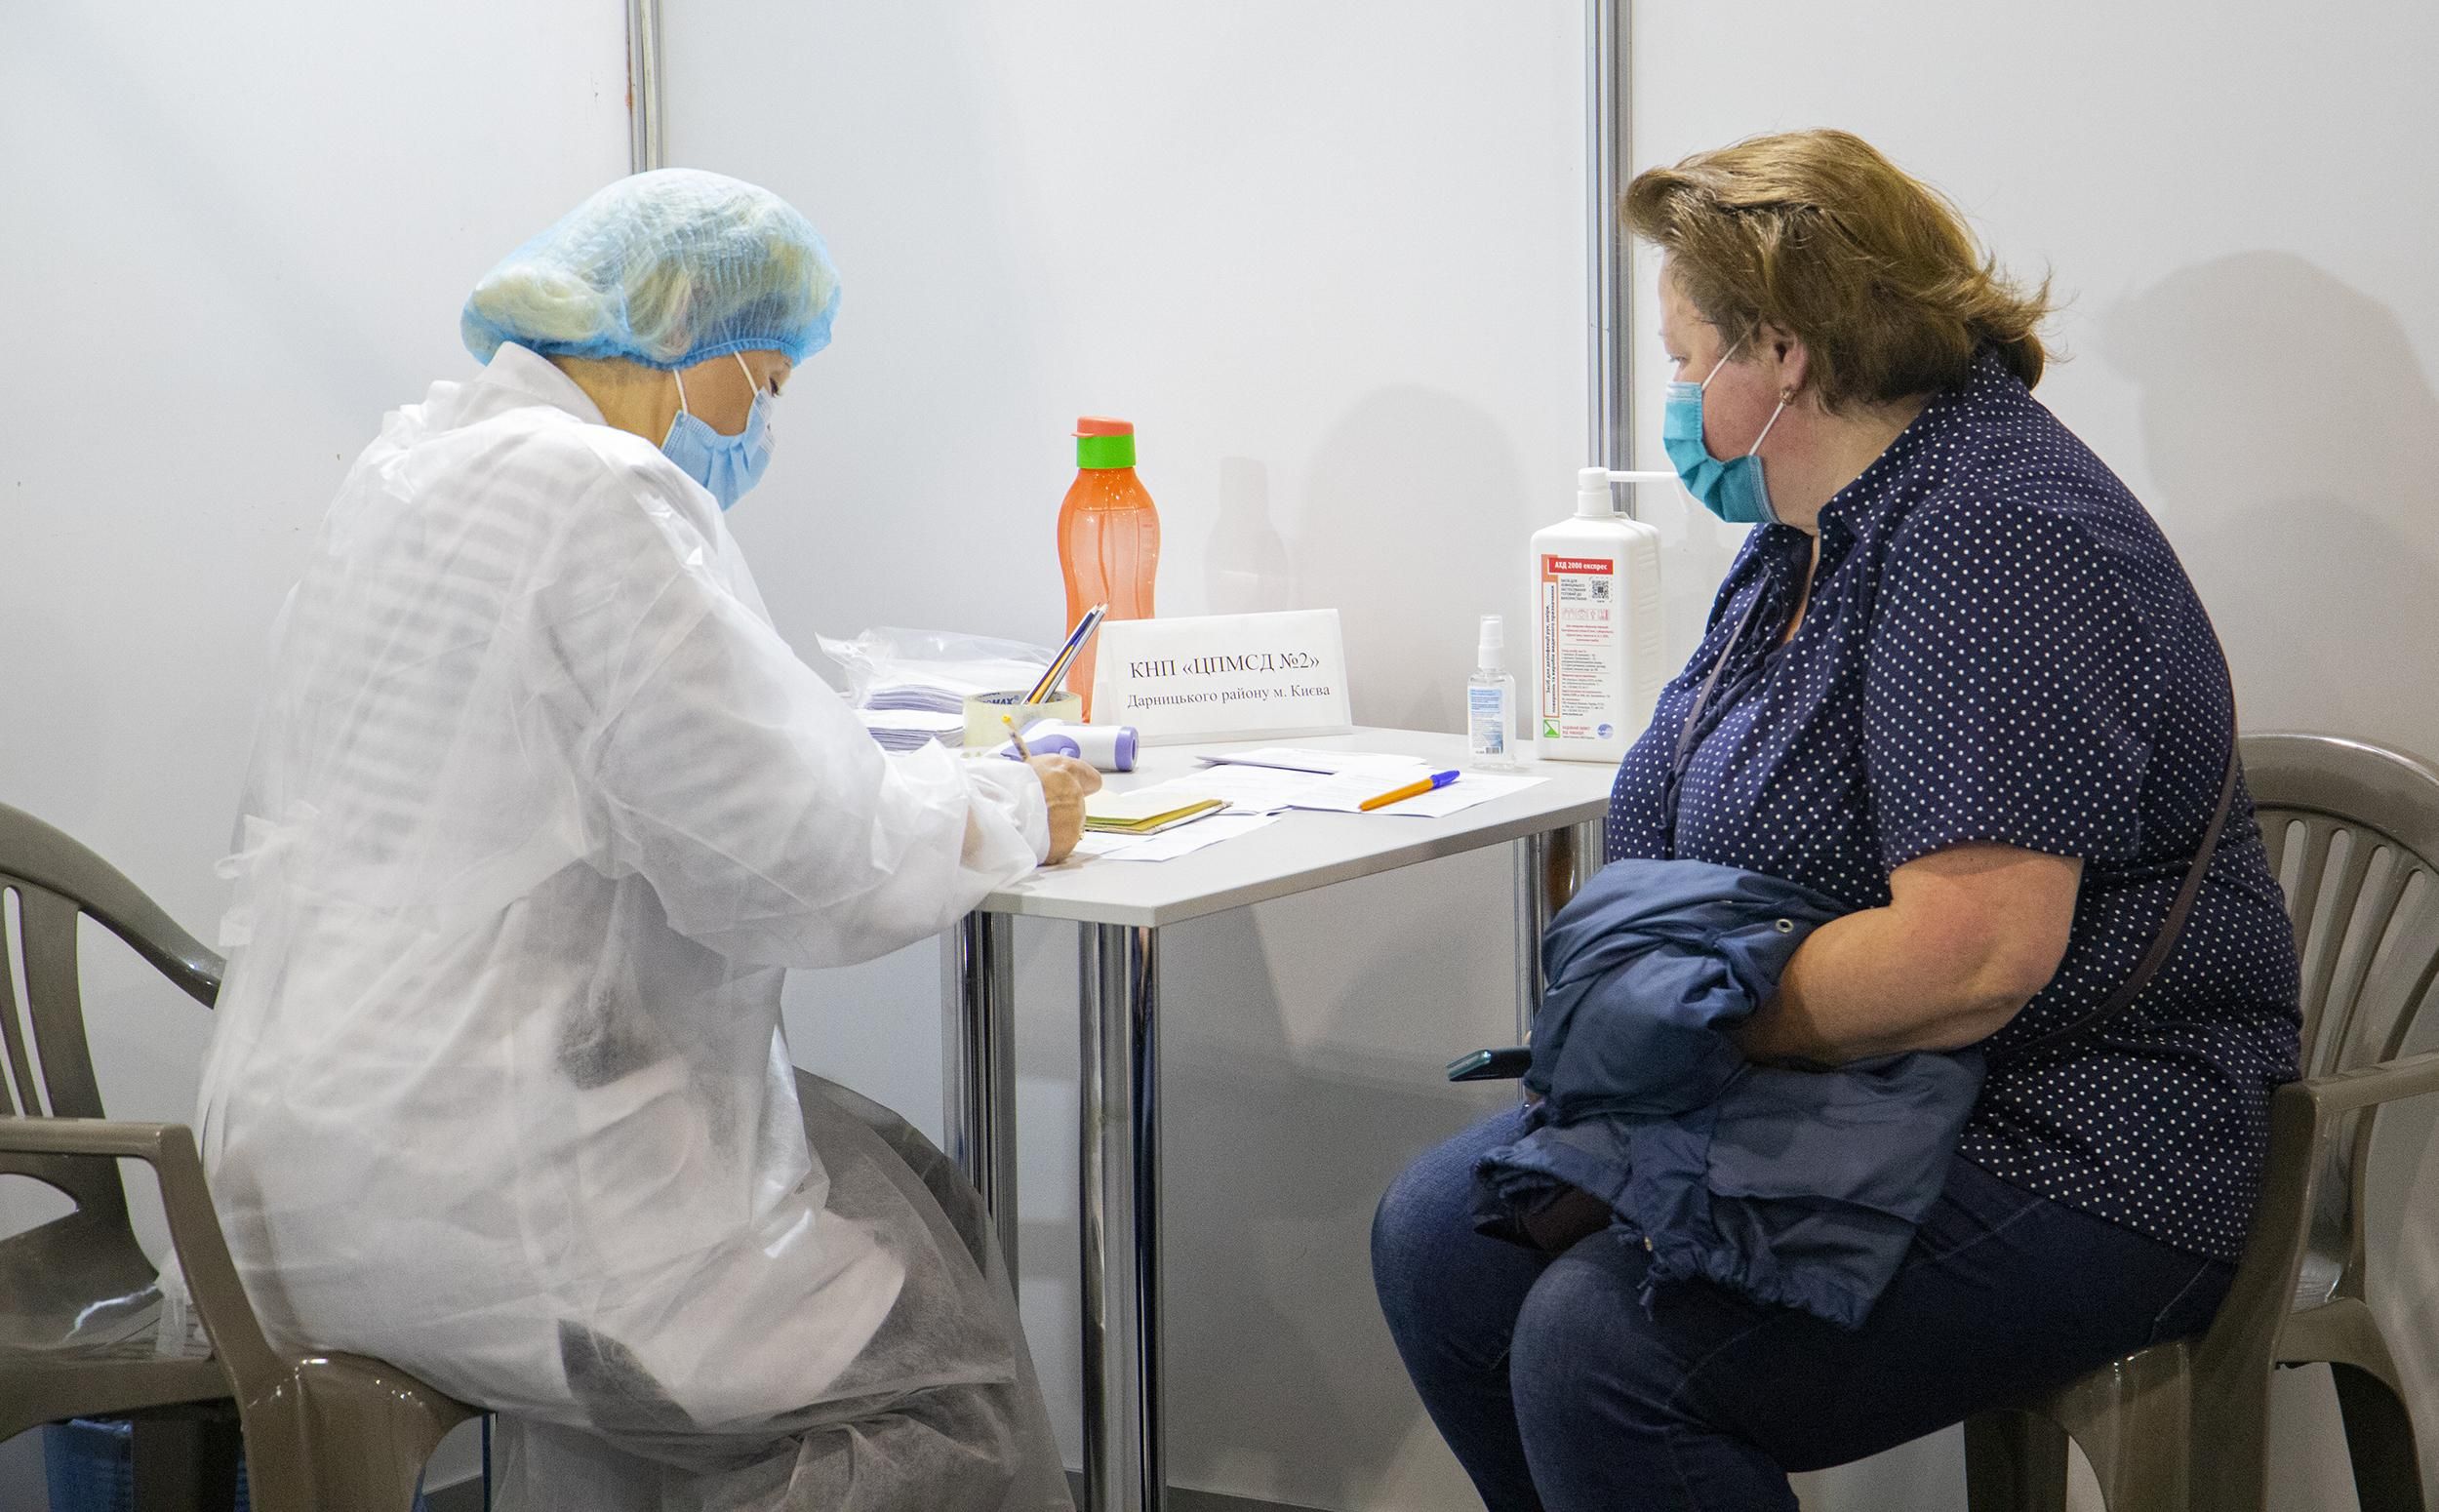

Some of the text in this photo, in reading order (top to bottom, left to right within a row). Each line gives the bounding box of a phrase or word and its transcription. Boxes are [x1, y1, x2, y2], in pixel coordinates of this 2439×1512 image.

[1130, 652, 1321, 679] КНП «ЦПМСД №2»
[1127, 684, 1331, 709] Дарницького району м. Києва
